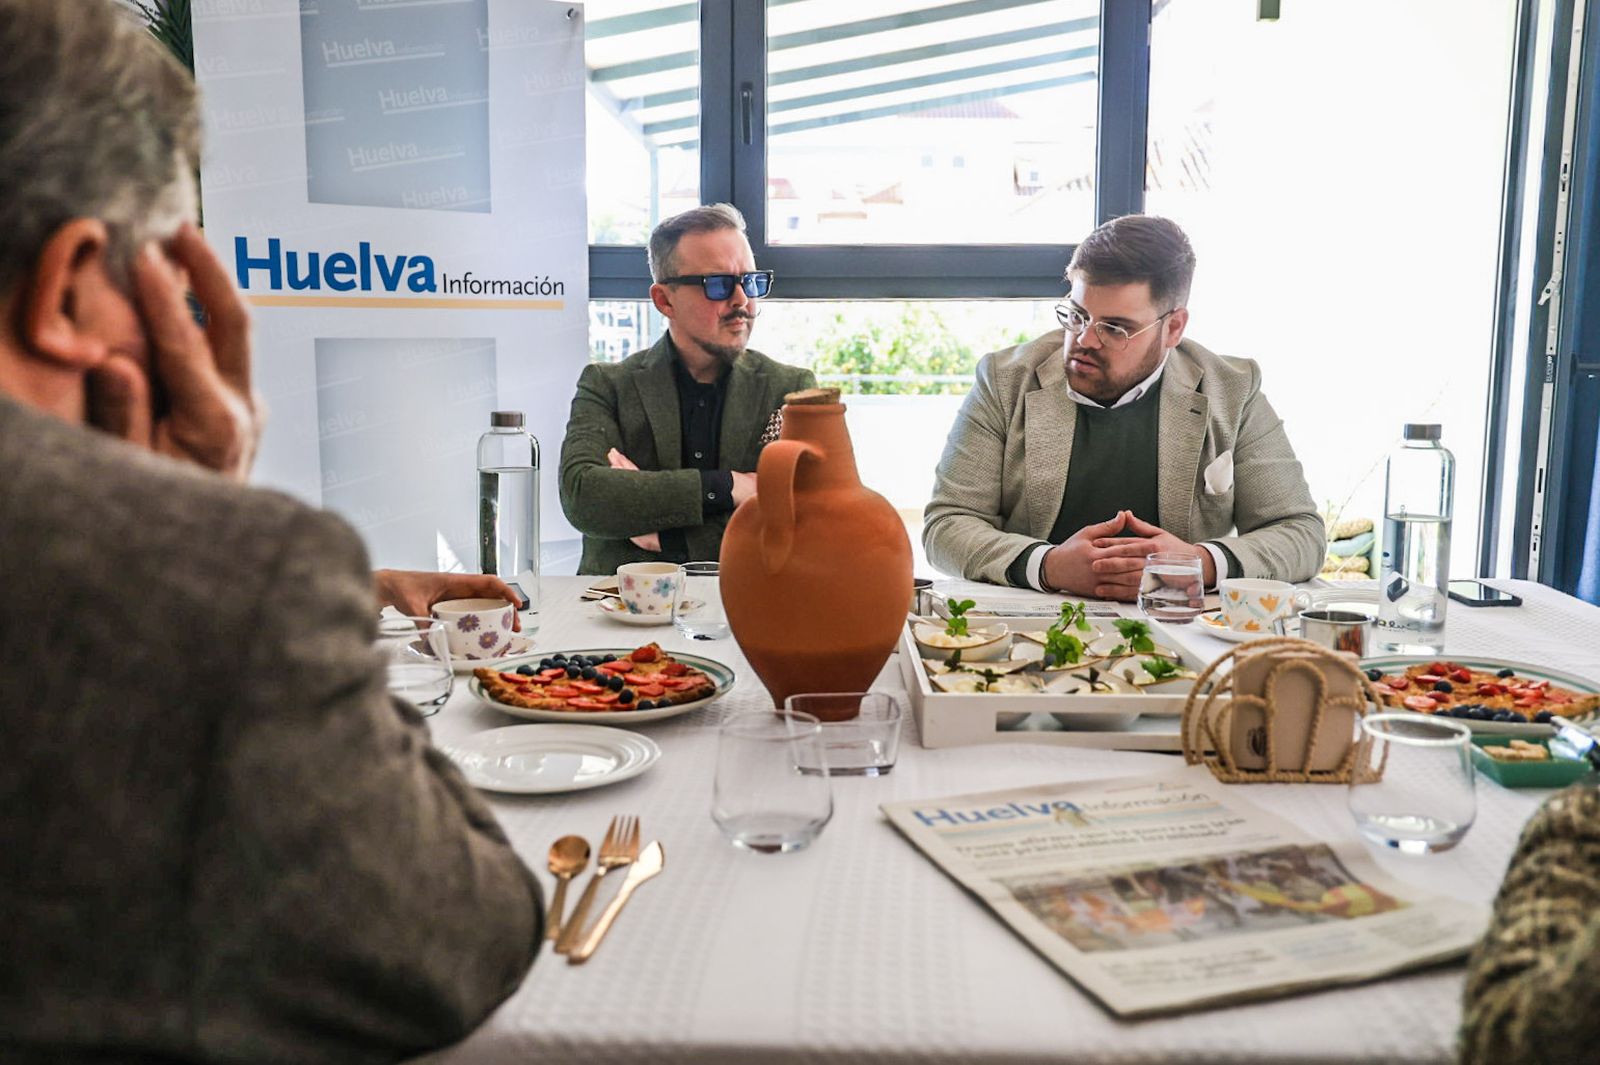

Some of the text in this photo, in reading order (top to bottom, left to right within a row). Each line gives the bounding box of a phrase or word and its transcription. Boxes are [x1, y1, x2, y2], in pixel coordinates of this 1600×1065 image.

[321, 38, 396, 63] Huelva
[378, 85, 448, 110] Huelva
[346, 141, 419, 167] Huelva
[401, 186, 468, 208] Huelva
[234, 236, 564, 296] Huelva Información
[912, 799, 1083, 827] Huelva
